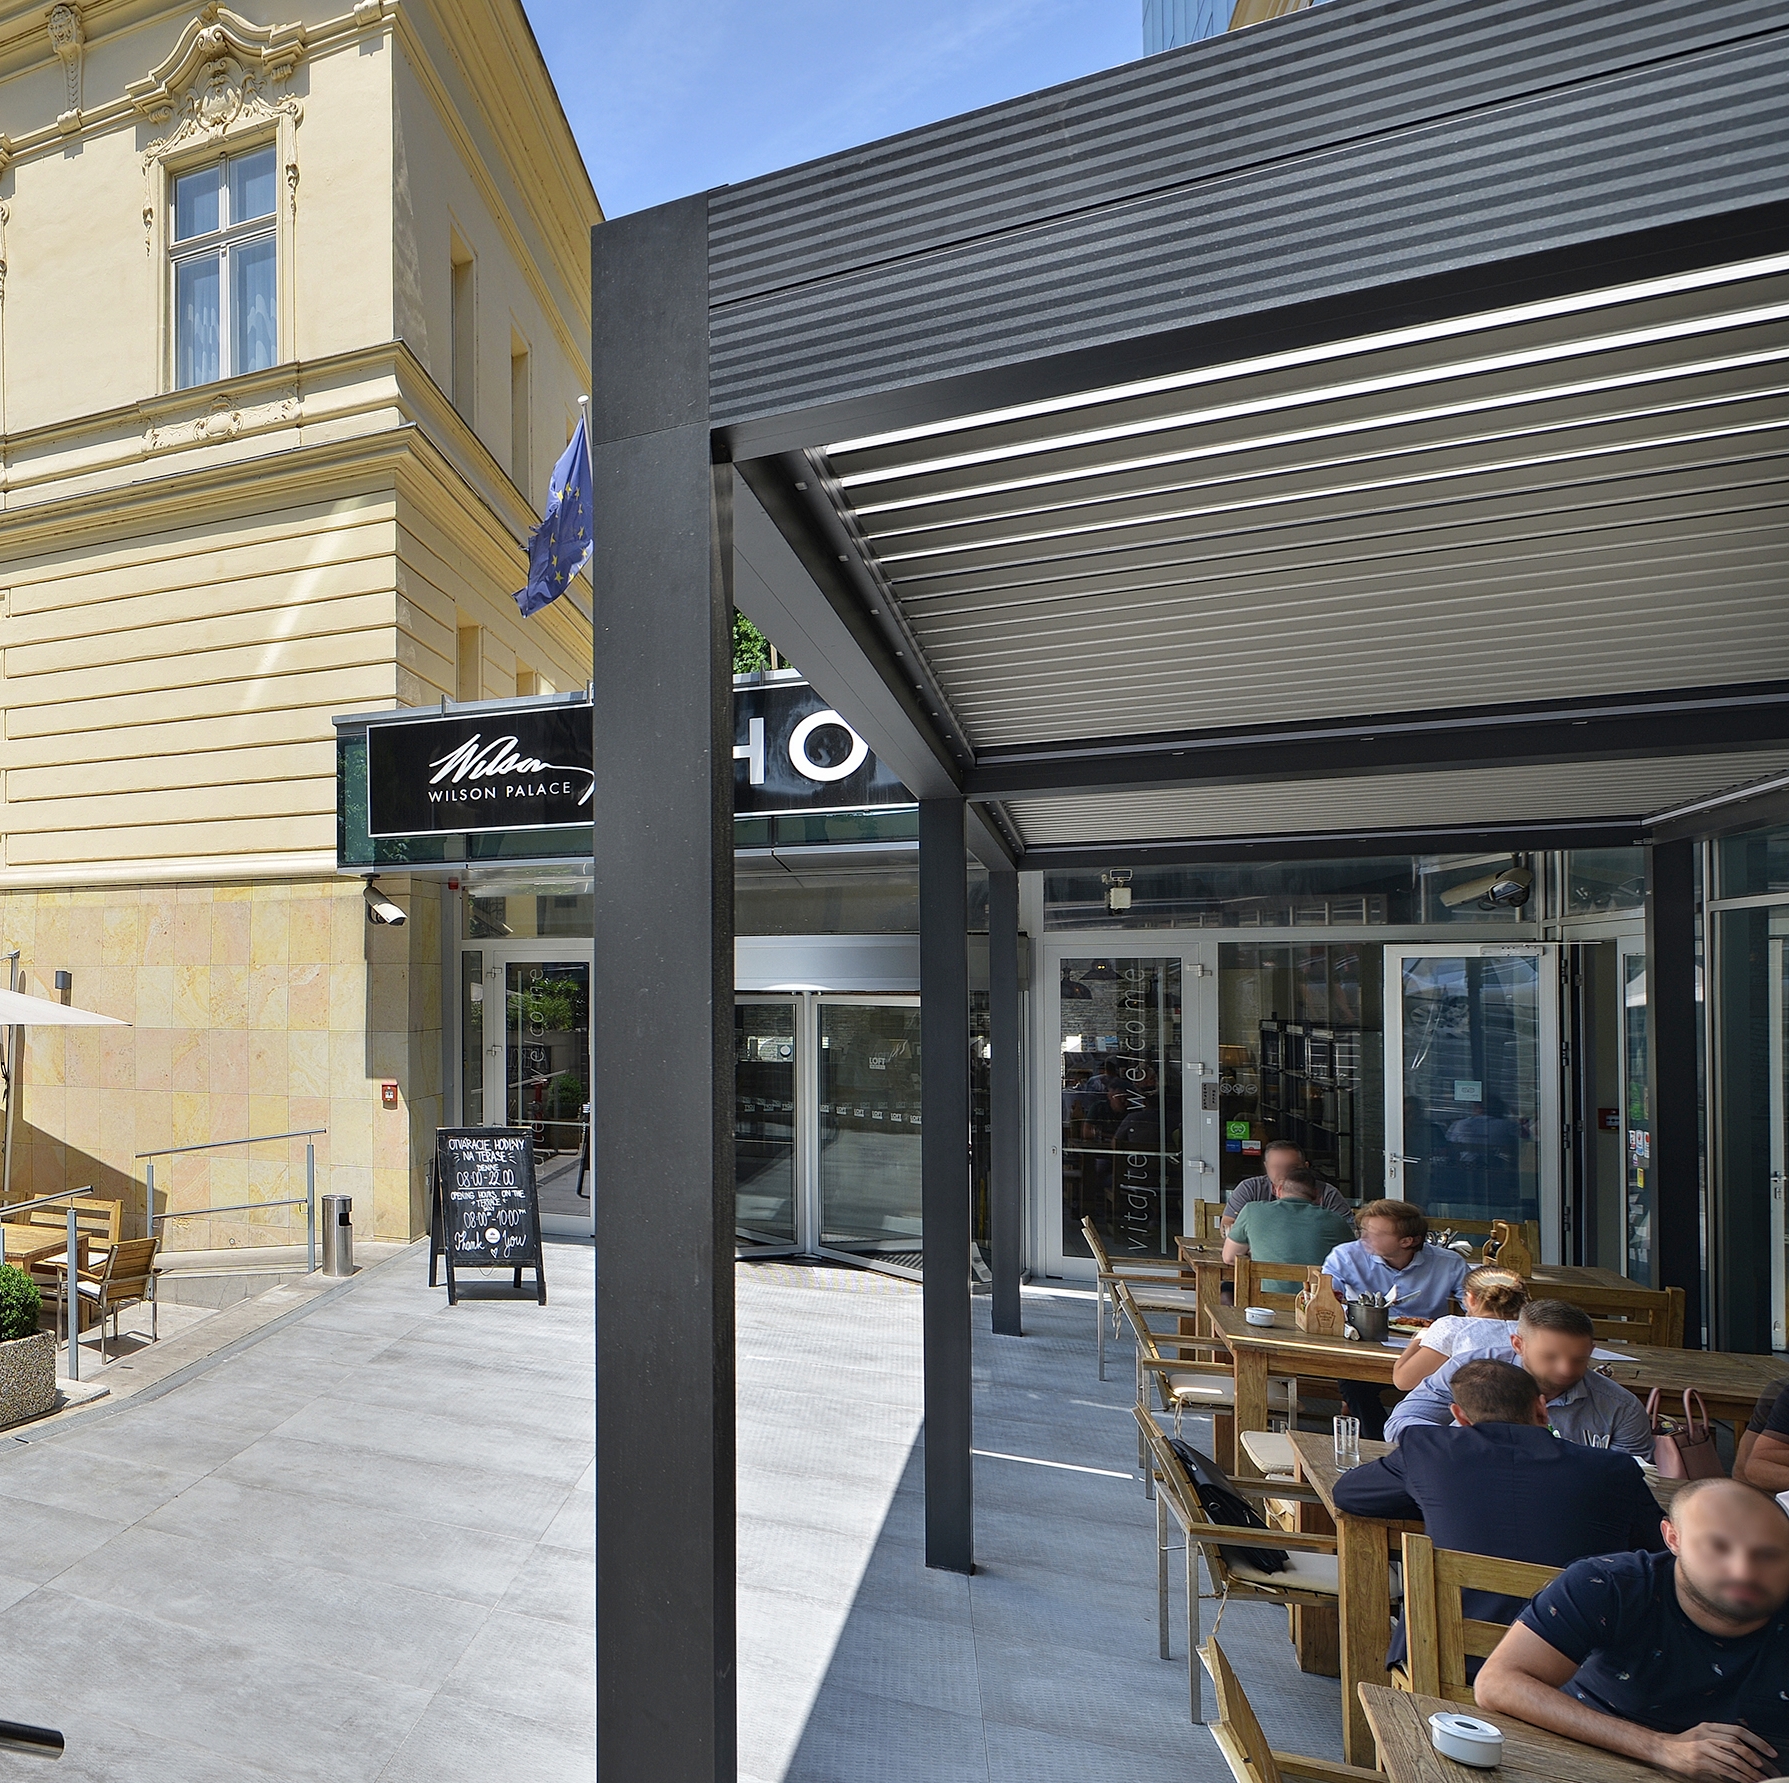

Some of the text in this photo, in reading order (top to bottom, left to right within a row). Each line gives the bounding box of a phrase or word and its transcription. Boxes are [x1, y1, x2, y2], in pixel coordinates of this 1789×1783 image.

[429, 733, 595, 794] Wilson
[428, 781, 571, 803] WILSON PALACE
[869, 1057, 886, 1065] LOFT
[1116, 968, 1157, 1252] vitajte welcome
[462, 1150, 508, 1163] NA TERASE
[450, 1189, 526, 1200] OPENING HOURS ON THE
[454, 1229, 527, 1258] Thank You
